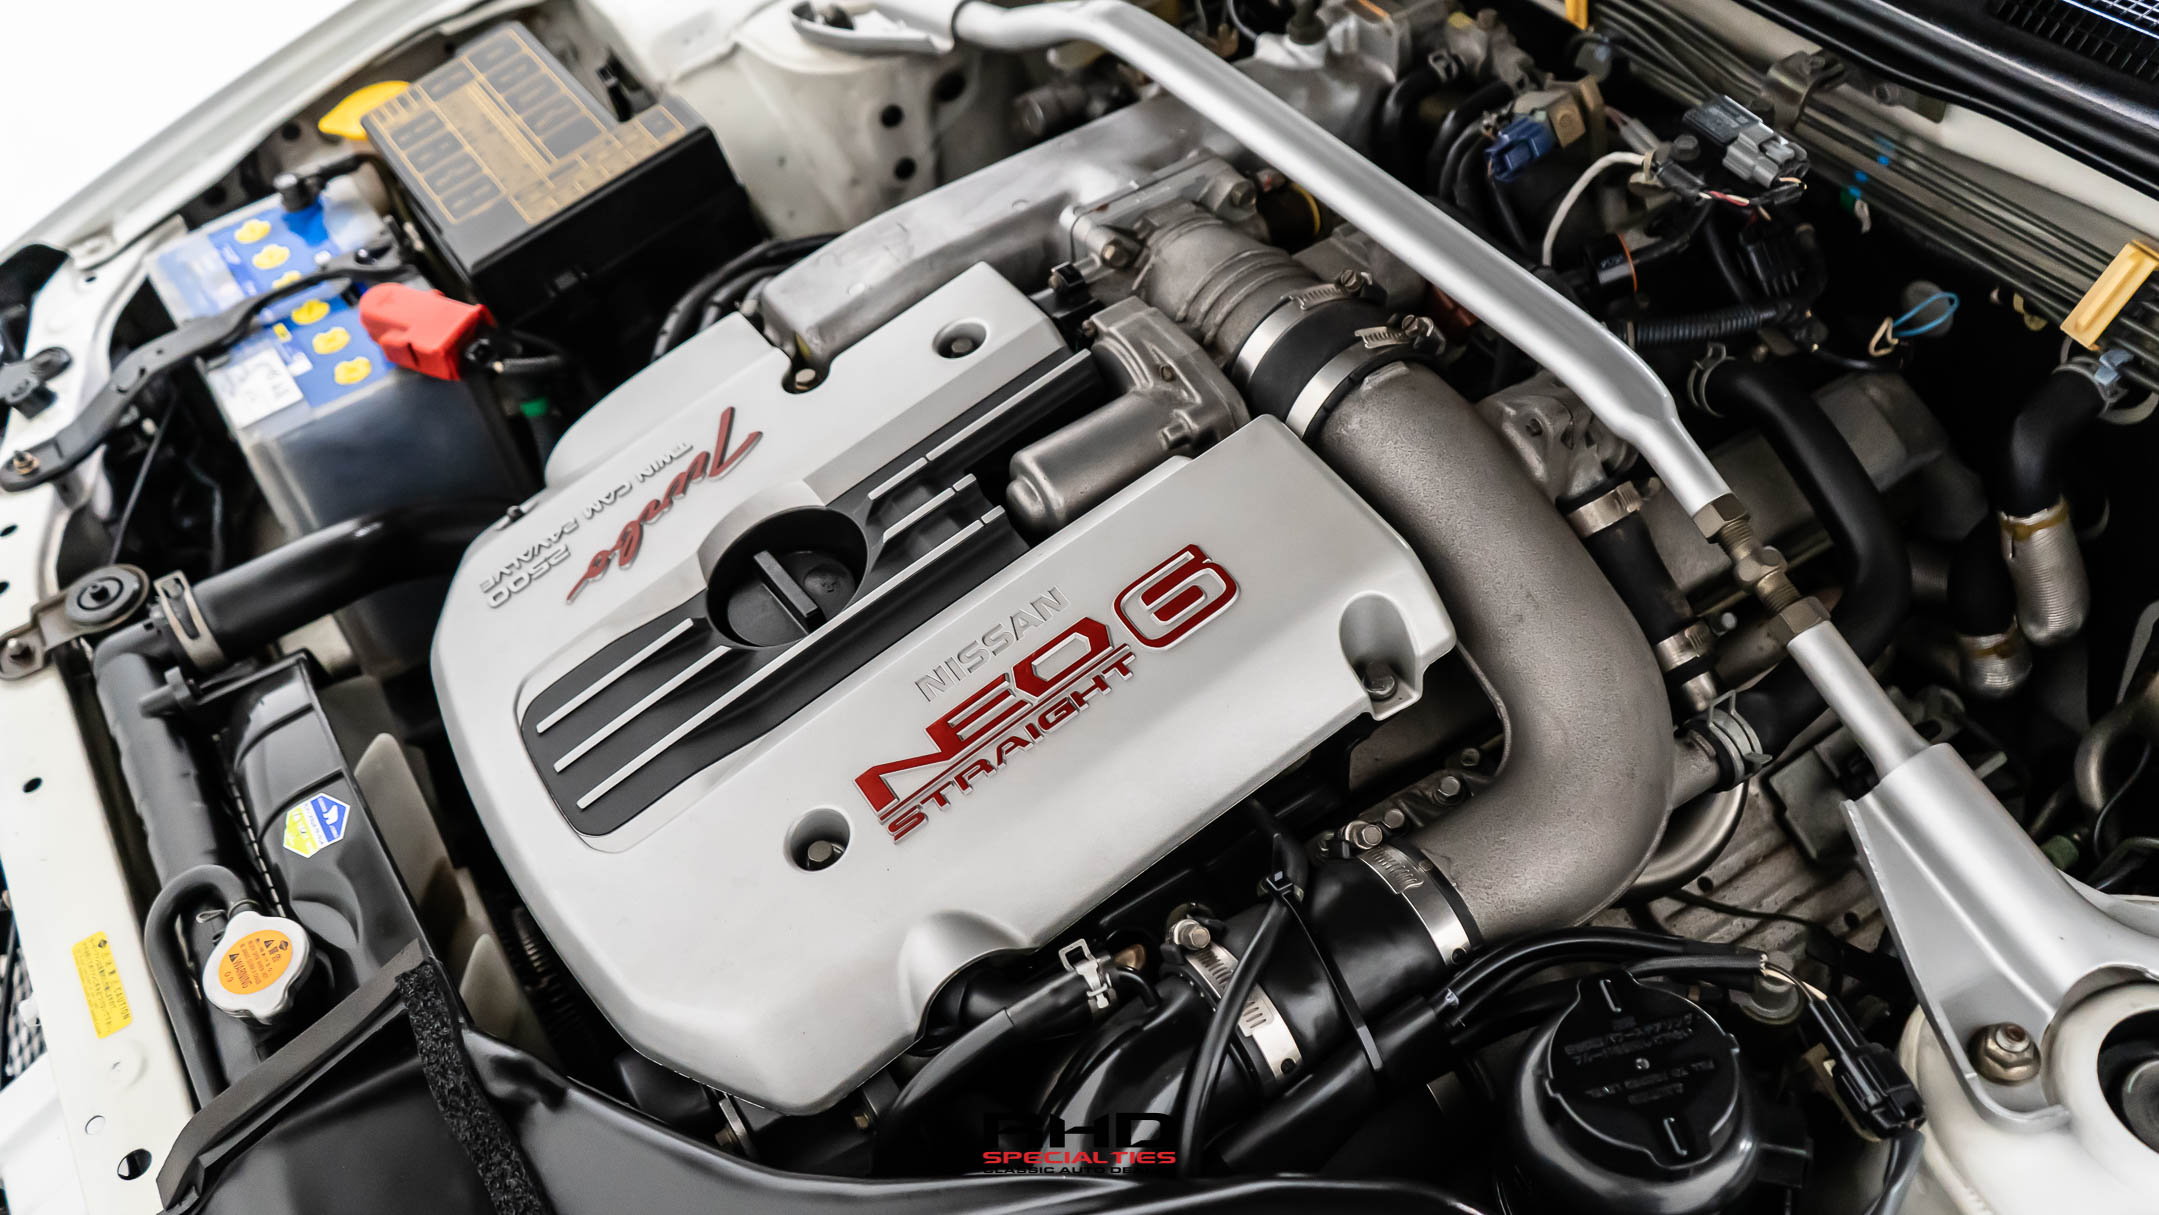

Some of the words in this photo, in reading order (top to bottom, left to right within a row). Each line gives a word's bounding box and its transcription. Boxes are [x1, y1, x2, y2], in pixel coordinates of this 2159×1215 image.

[566, 406, 763, 606] Turbo
[583, 480, 633, 521] CAM
[637, 441, 694, 484] TWIN
[487, 543, 571, 609] 2500
[853, 615, 1114, 815] NEO
[1112, 543, 1241, 652] 6
[914, 585, 1071, 702] NISSAN
[887, 650, 1137, 845] STRAIGHT
